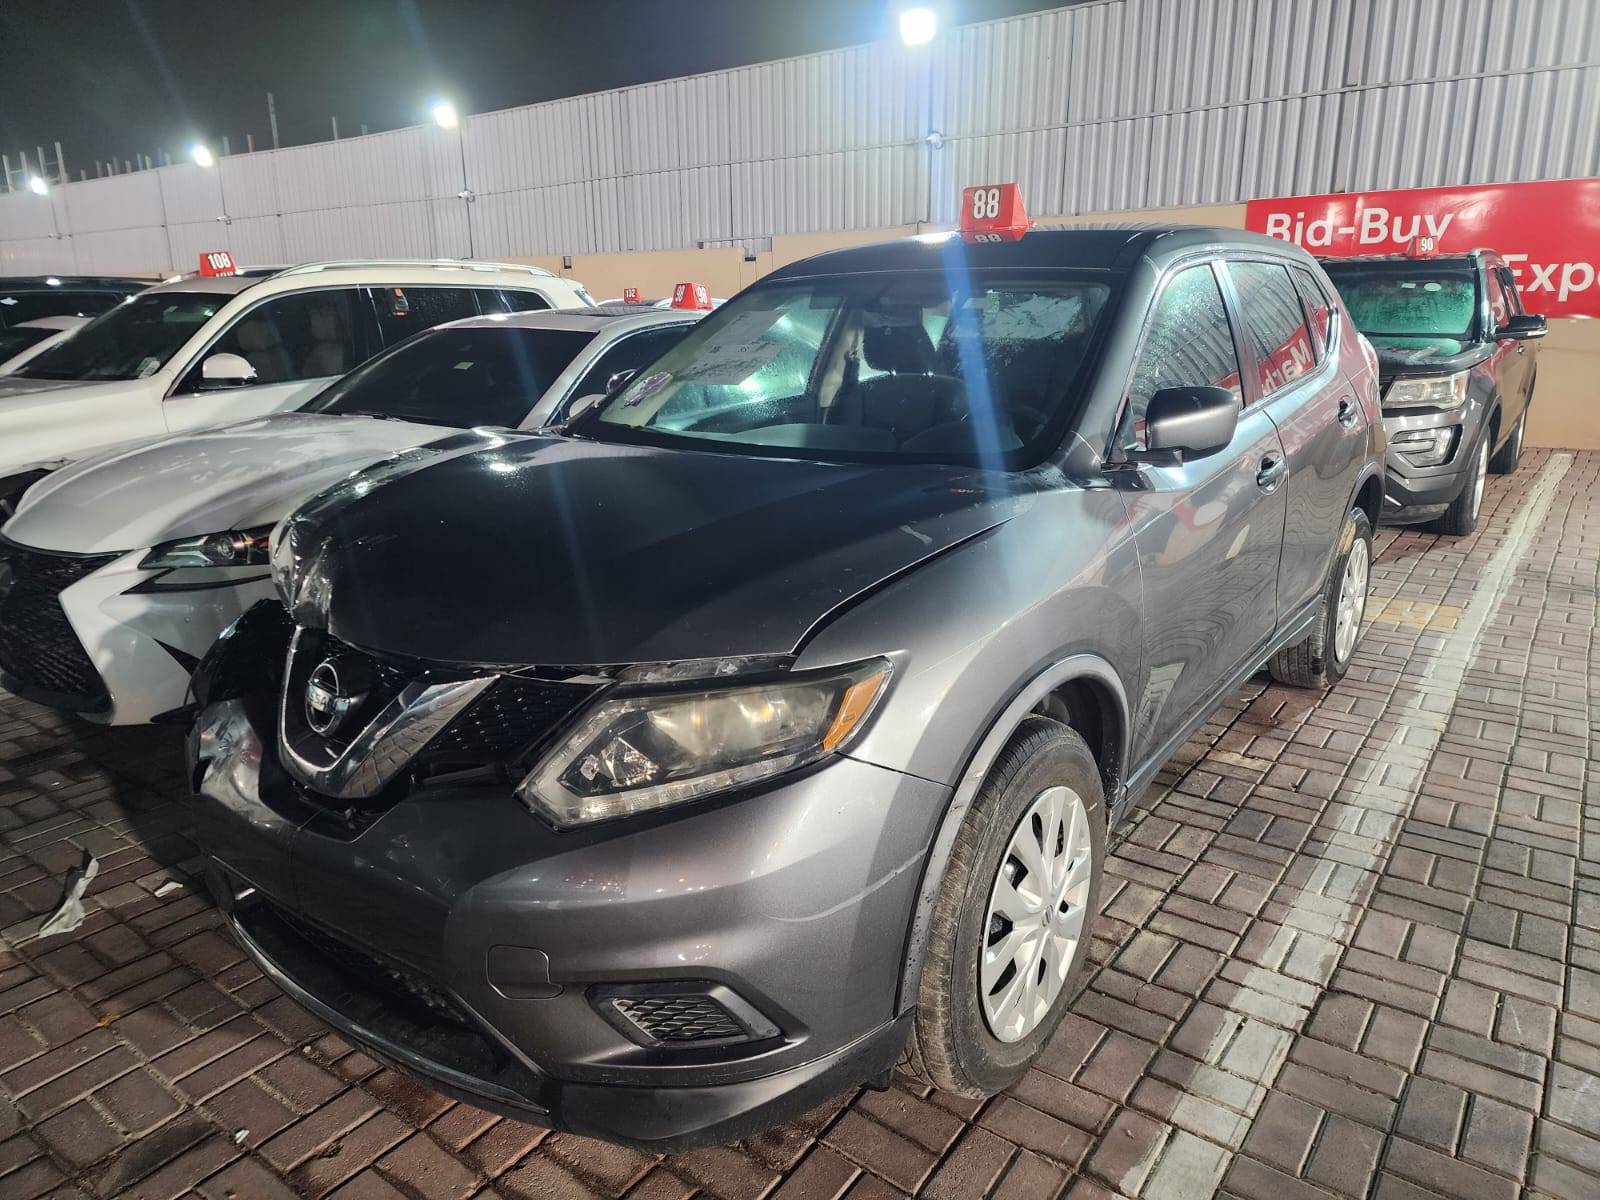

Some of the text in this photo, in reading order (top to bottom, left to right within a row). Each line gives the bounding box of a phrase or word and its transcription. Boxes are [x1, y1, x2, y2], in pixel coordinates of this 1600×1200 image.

[973, 188, 1000, 219] 88
[1266, 207, 1453, 247] Bid-Buy
[1421, 237, 1434, 251] 90
[207, 252, 232, 270] 108
[1501, 253, 1600, 302] Exp
